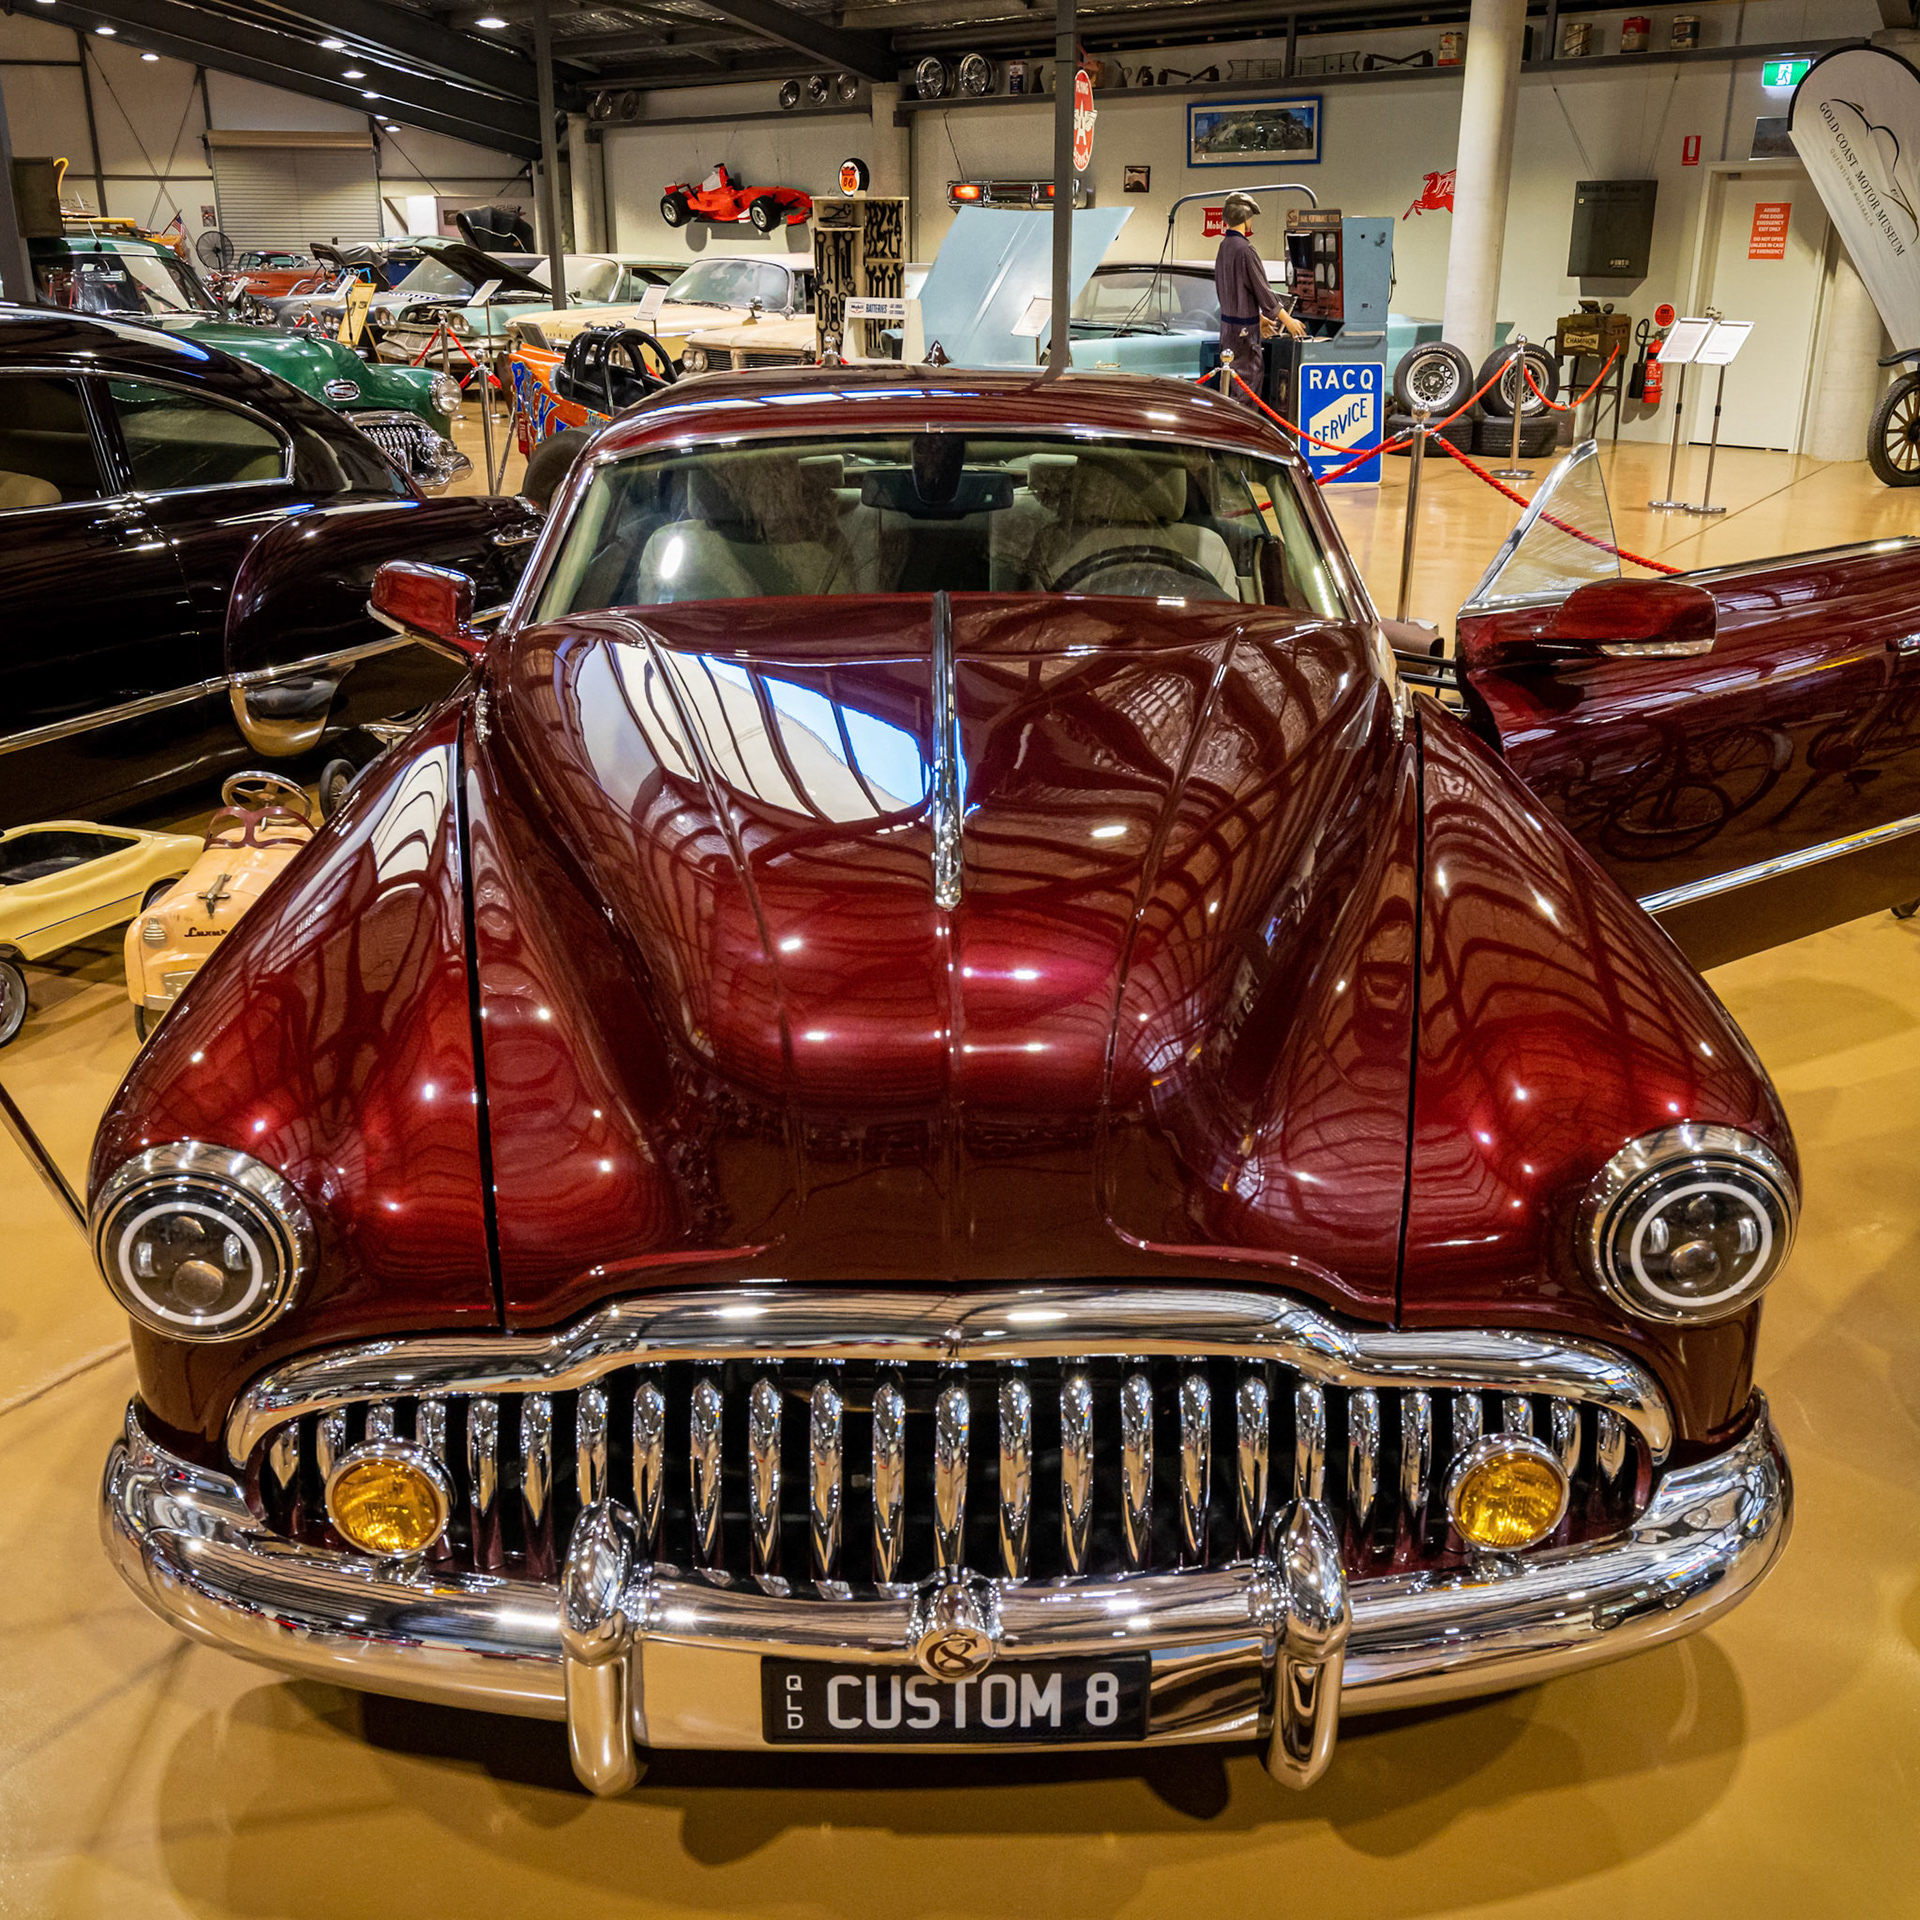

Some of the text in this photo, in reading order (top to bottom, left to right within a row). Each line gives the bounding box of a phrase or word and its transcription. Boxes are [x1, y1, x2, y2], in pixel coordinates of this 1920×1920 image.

[1819, 102, 1906, 257] GOLD COAST MOTOR MUSEUM
[1829, 148, 1874, 227] QUEENSLAND AUSTRALIA
[1309, 368, 1374, 391] RACQ
[1312, 398, 1368, 451] SERVICE
[785, 1674, 804, 1730] QLD
[826, 1671, 1120, 1730] CUSTOM 8
